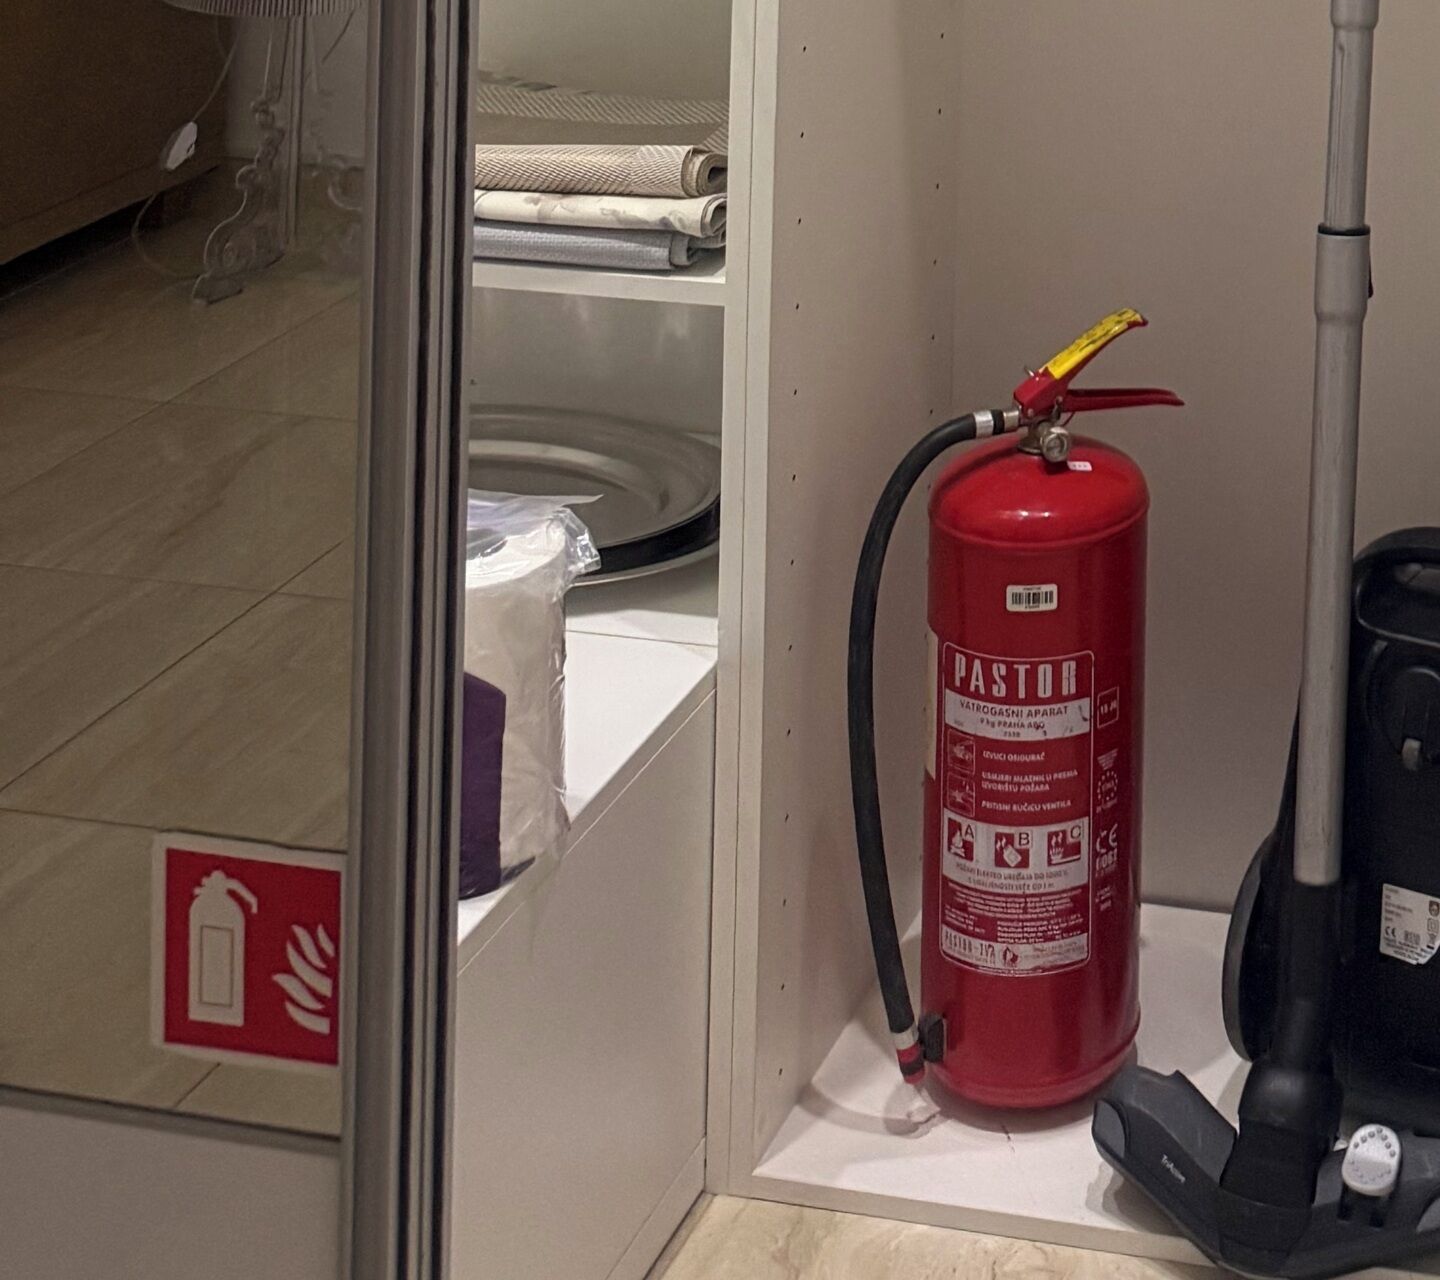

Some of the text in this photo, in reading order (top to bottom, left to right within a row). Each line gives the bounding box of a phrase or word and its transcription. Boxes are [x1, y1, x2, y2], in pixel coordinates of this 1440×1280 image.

[954, 651, 1078, 701] PASTOR
[959, 699, 1069, 719] VATROGASNI APARAT
[963, 823, 975, 840] A
[1018, 831, 1031, 847] B
[1069, 824, 1082, 840] C
